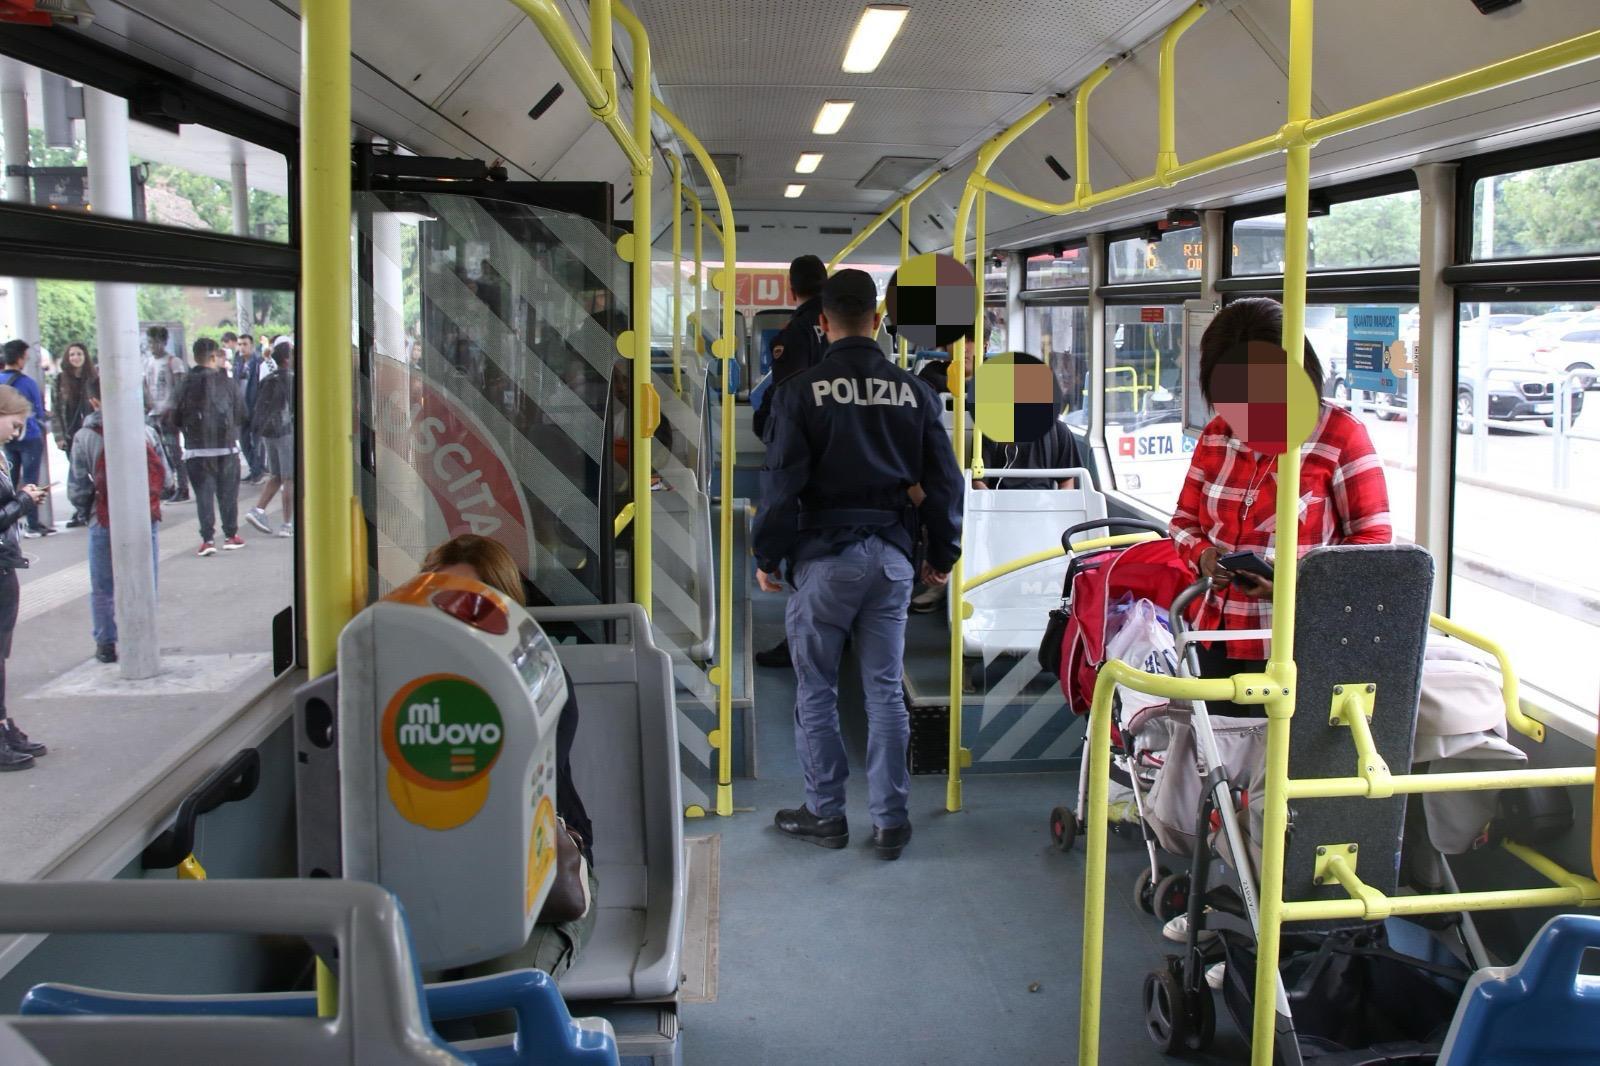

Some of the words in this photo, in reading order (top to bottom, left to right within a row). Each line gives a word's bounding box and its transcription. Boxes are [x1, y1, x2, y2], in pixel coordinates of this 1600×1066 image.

[811, 378, 918, 408] POLIZIA
[1138, 435, 1173, 455] SETA
[383, 391, 503, 536] USCITA
[408, 697, 440, 724] mi
